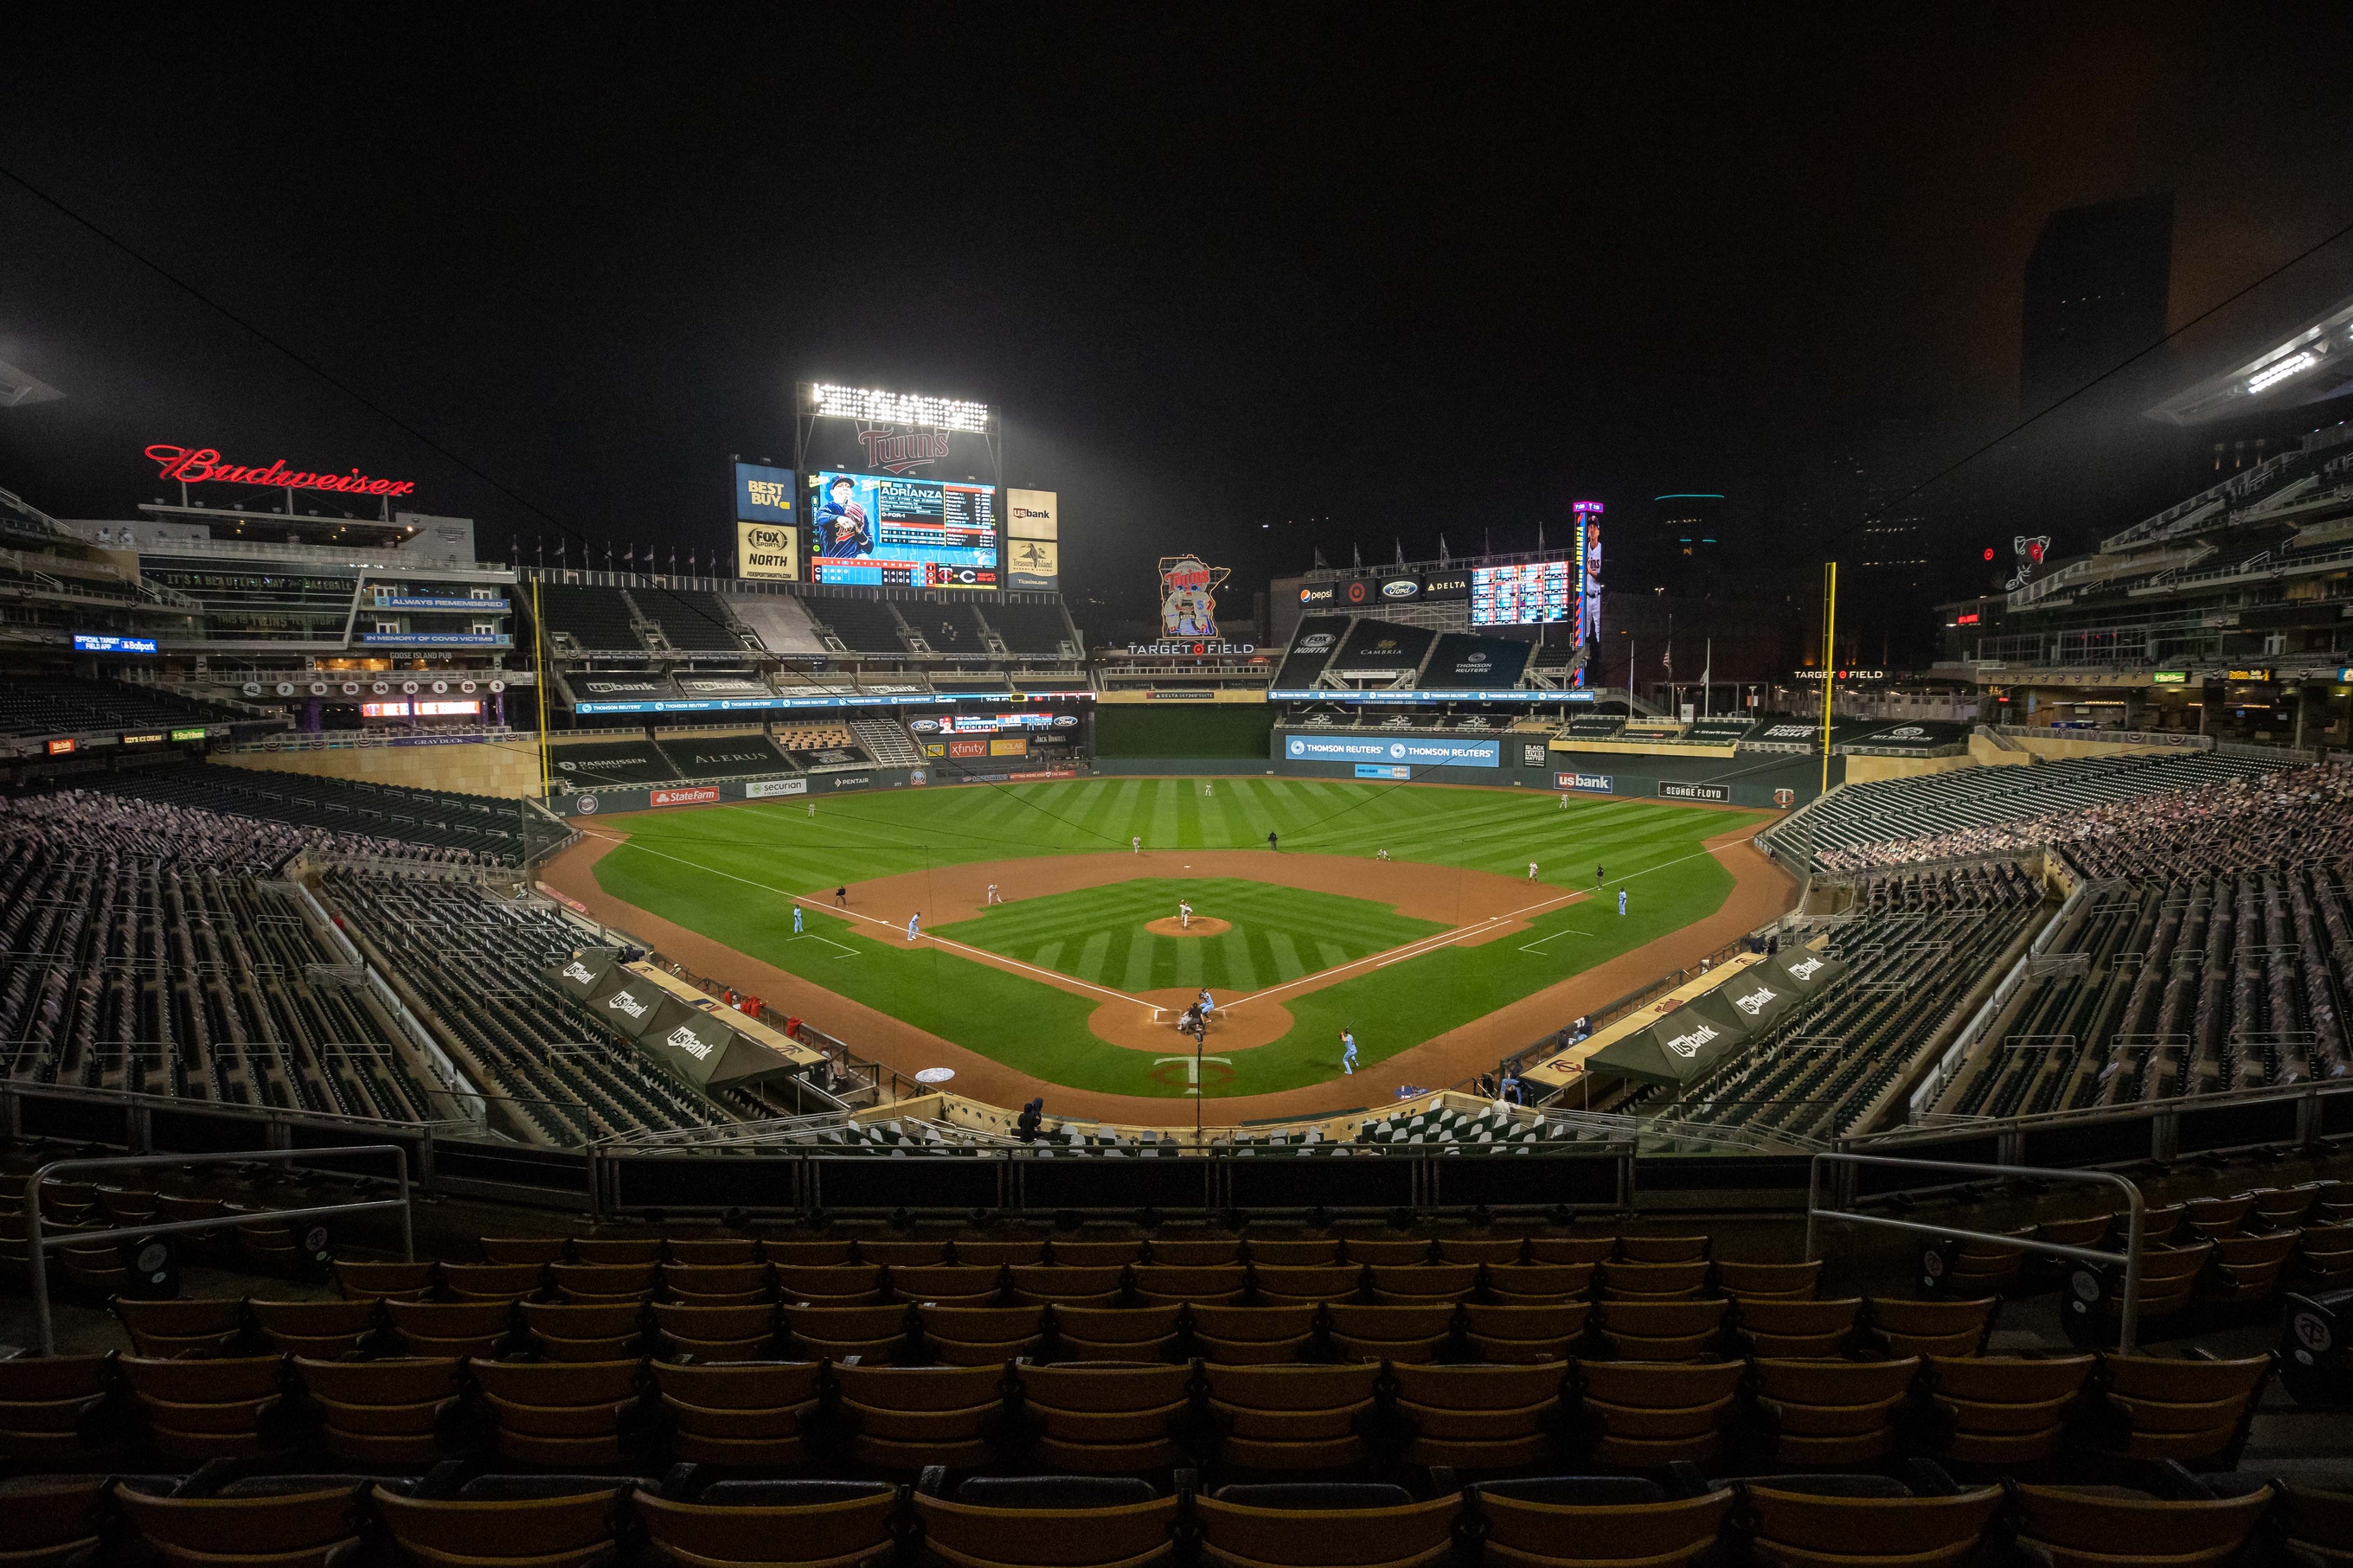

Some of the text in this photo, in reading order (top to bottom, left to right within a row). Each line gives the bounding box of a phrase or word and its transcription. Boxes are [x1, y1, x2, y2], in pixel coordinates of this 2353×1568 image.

[858, 426, 948, 468] Twins
[144, 445, 414, 496] Budweiser
[747, 479, 784, 496] BEST
[882, 488, 943, 498] ADRIANZA
[751, 493, 781, 507] BUY
[1014, 508, 1050, 519] usbank
[756, 531, 779, 543] FOX
[749, 554, 787, 566] NORTH
[1013, 559, 1052, 569] Treasure Island
[747, 571, 792, 579] FOXSPORTSNORTH.COM
[1164, 569, 1210, 593] Twins
[196, 575, 202, 586] A
[305, 579, 353, 592] BASEBALL
[1311, 581, 1465, 600] pepsi Ford DELTA
[129, 641, 156, 652] Ballpark
[1128, 644, 1254, 654] TARGET FIELD
[952, 743, 984, 756] xfinity
[1307, 744, 1381, 754] THOMSON REUTERS
[1408, 747, 1490, 758] THOMSON REUTERS
[578, 758, 647, 766] RASMUSSEN
[696, 752, 768, 764] ALERUS
[764, 782, 802, 791] securian
[1559, 775, 1609, 788] usbank
[1666, 787, 1721, 798] GEORGE FLOYD
[563, 961, 597, 984] usbank
[1788, 957, 1824, 981] usbank
[609, 990, 650, 1019] usbank
[1735, 986, 1777, 1014] usbank
[667, 1026, 714, 1061] usbank
[1667, 1024, 1720, 1057] usbank
